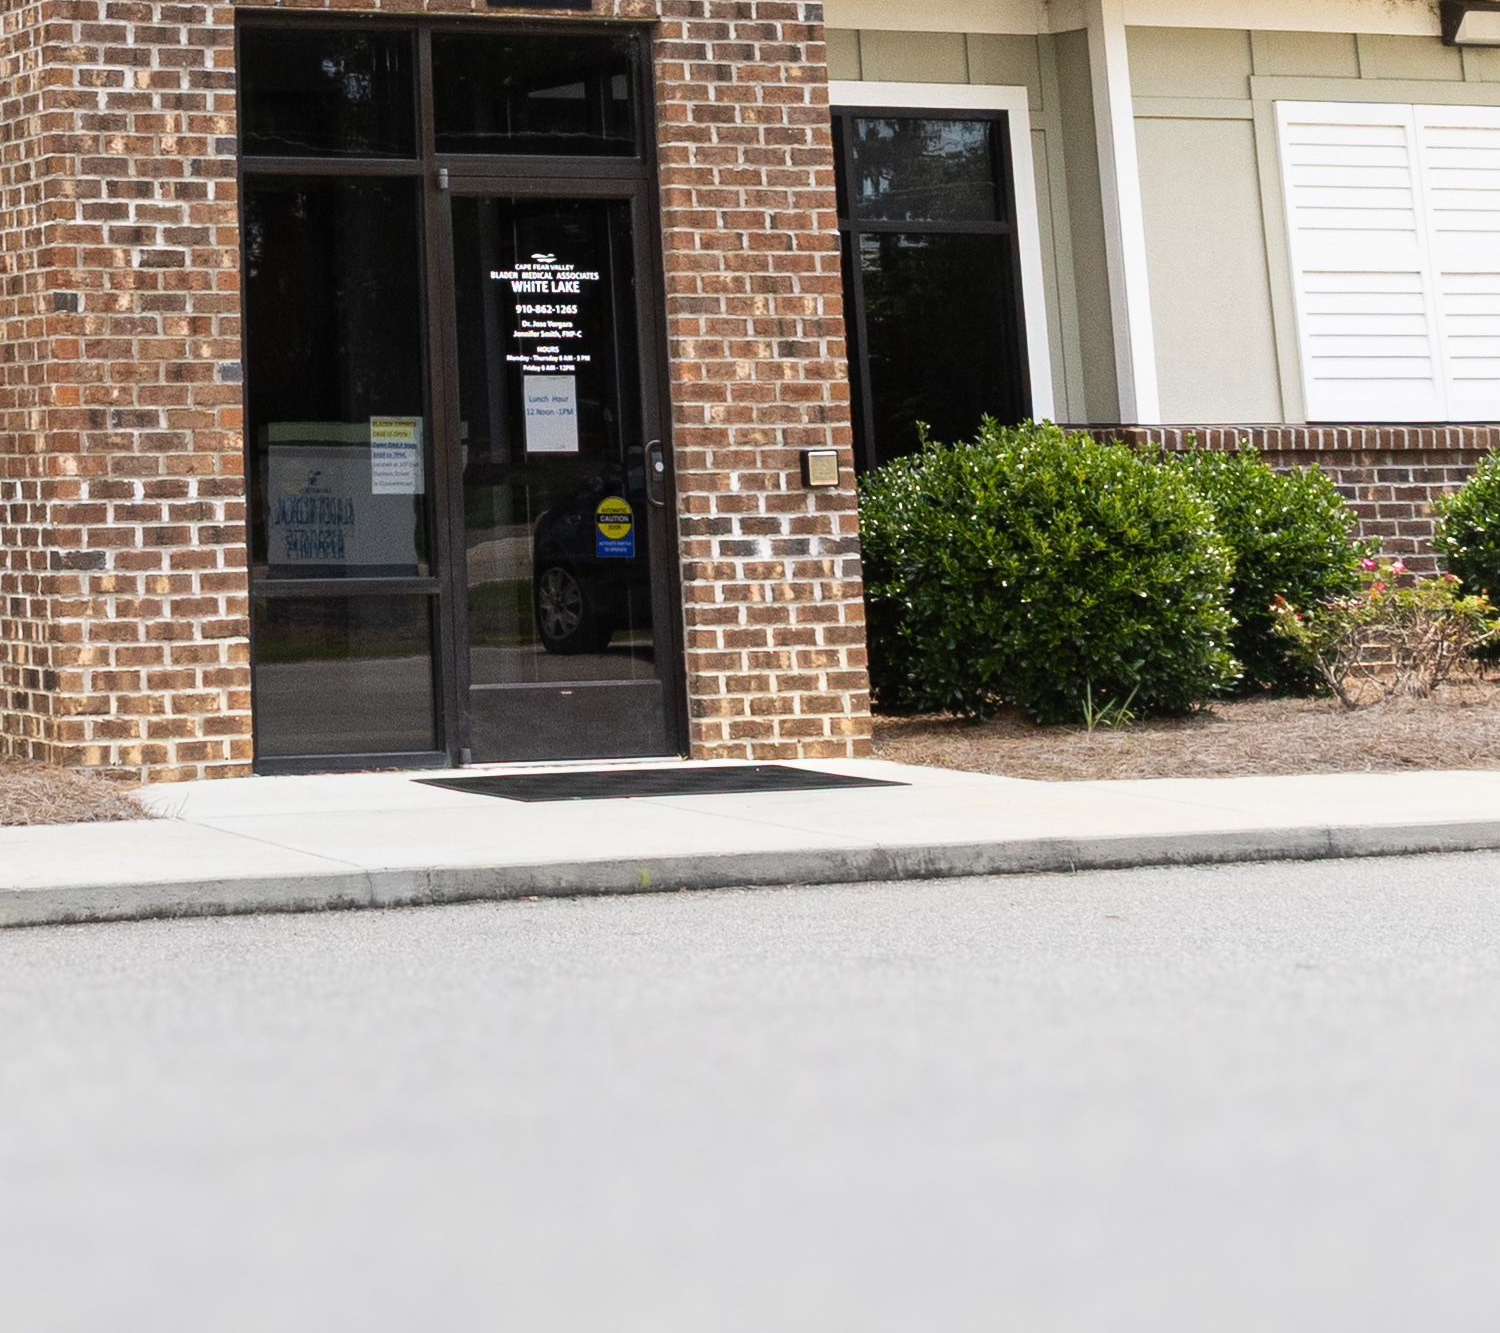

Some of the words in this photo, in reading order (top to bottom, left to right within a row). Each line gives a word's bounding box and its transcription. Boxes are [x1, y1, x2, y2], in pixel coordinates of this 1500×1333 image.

[490, 271, 518, 279] BLADEN
[522, 271, 553, 279] MEDICAL
[556, 272, 600, 280] ASSOCIATES
[511, 280, 549, 293] WHITE
[551, 281, 581, 293] LAKE
[515, 304, 578, 314] 910-862-1265
